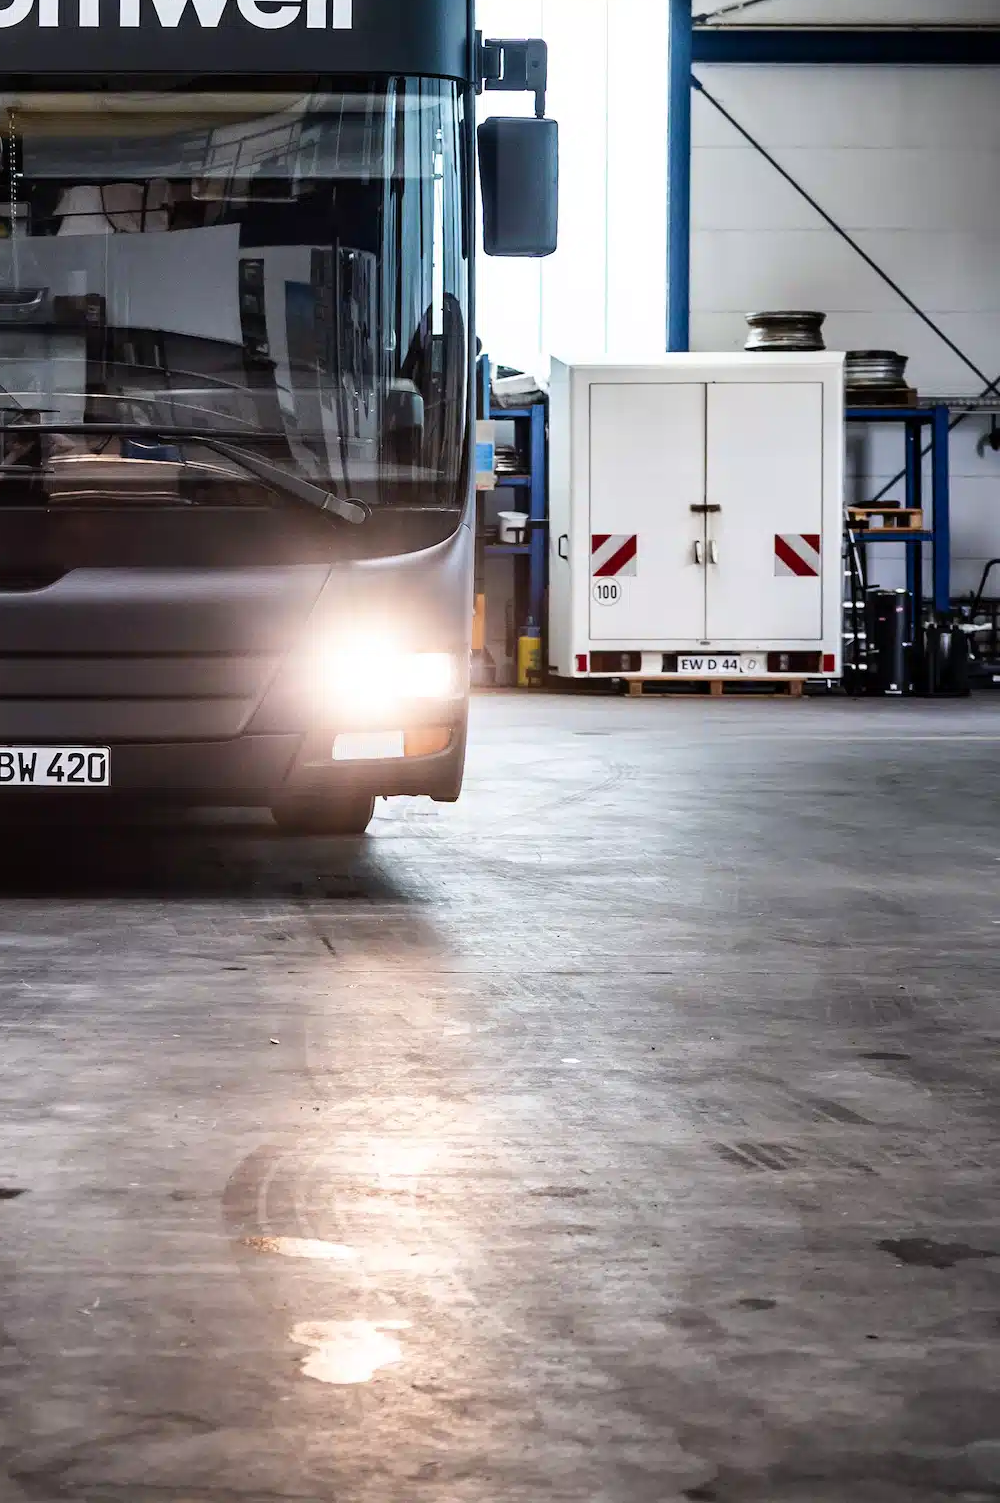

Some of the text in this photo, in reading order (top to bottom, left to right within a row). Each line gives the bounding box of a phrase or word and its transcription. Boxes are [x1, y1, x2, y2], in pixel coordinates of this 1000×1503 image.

[597, 585, 617, 599] 100
[681, 659, 738, 670] EW D 44
[46, 752, 106, 783] 420
